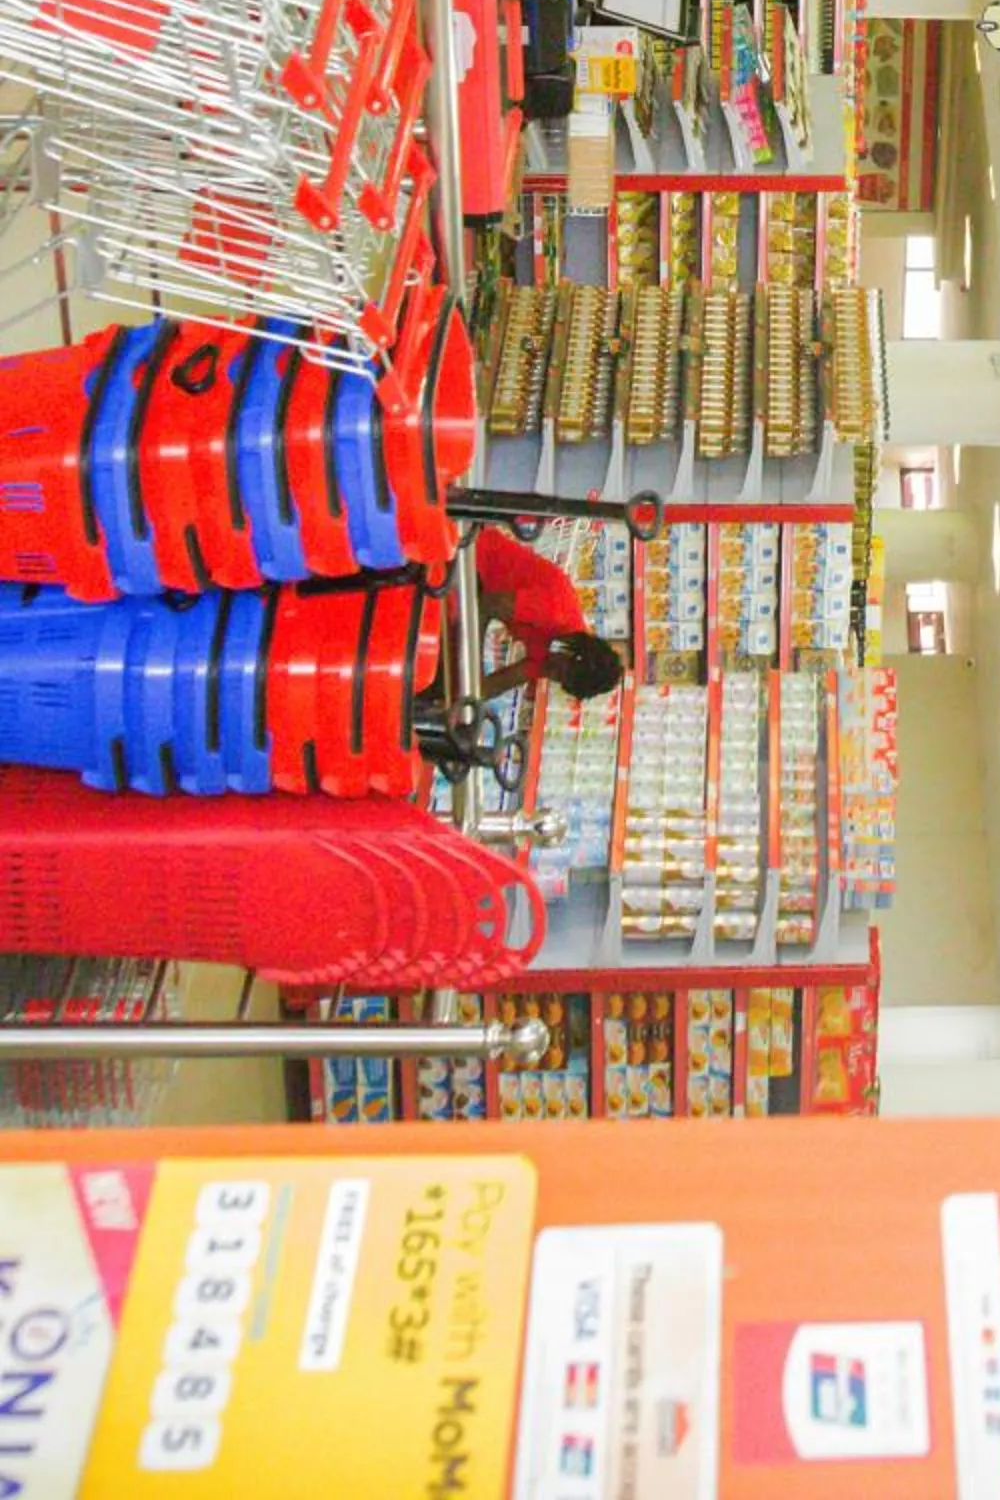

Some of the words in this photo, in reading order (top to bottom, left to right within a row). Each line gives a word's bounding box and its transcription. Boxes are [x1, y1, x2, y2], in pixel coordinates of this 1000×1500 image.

[335, 1190, 359, 1242] FREE
[455, 1182, 505, 1252] Pay
[331, 1253, 346, 1275] of
[629, 1262, 653, 1322] These
[443, 1274, 488, 1361] with
[575, 1276, 603, 1340] VISA
[426, 1377, 480, 1500] MoM
